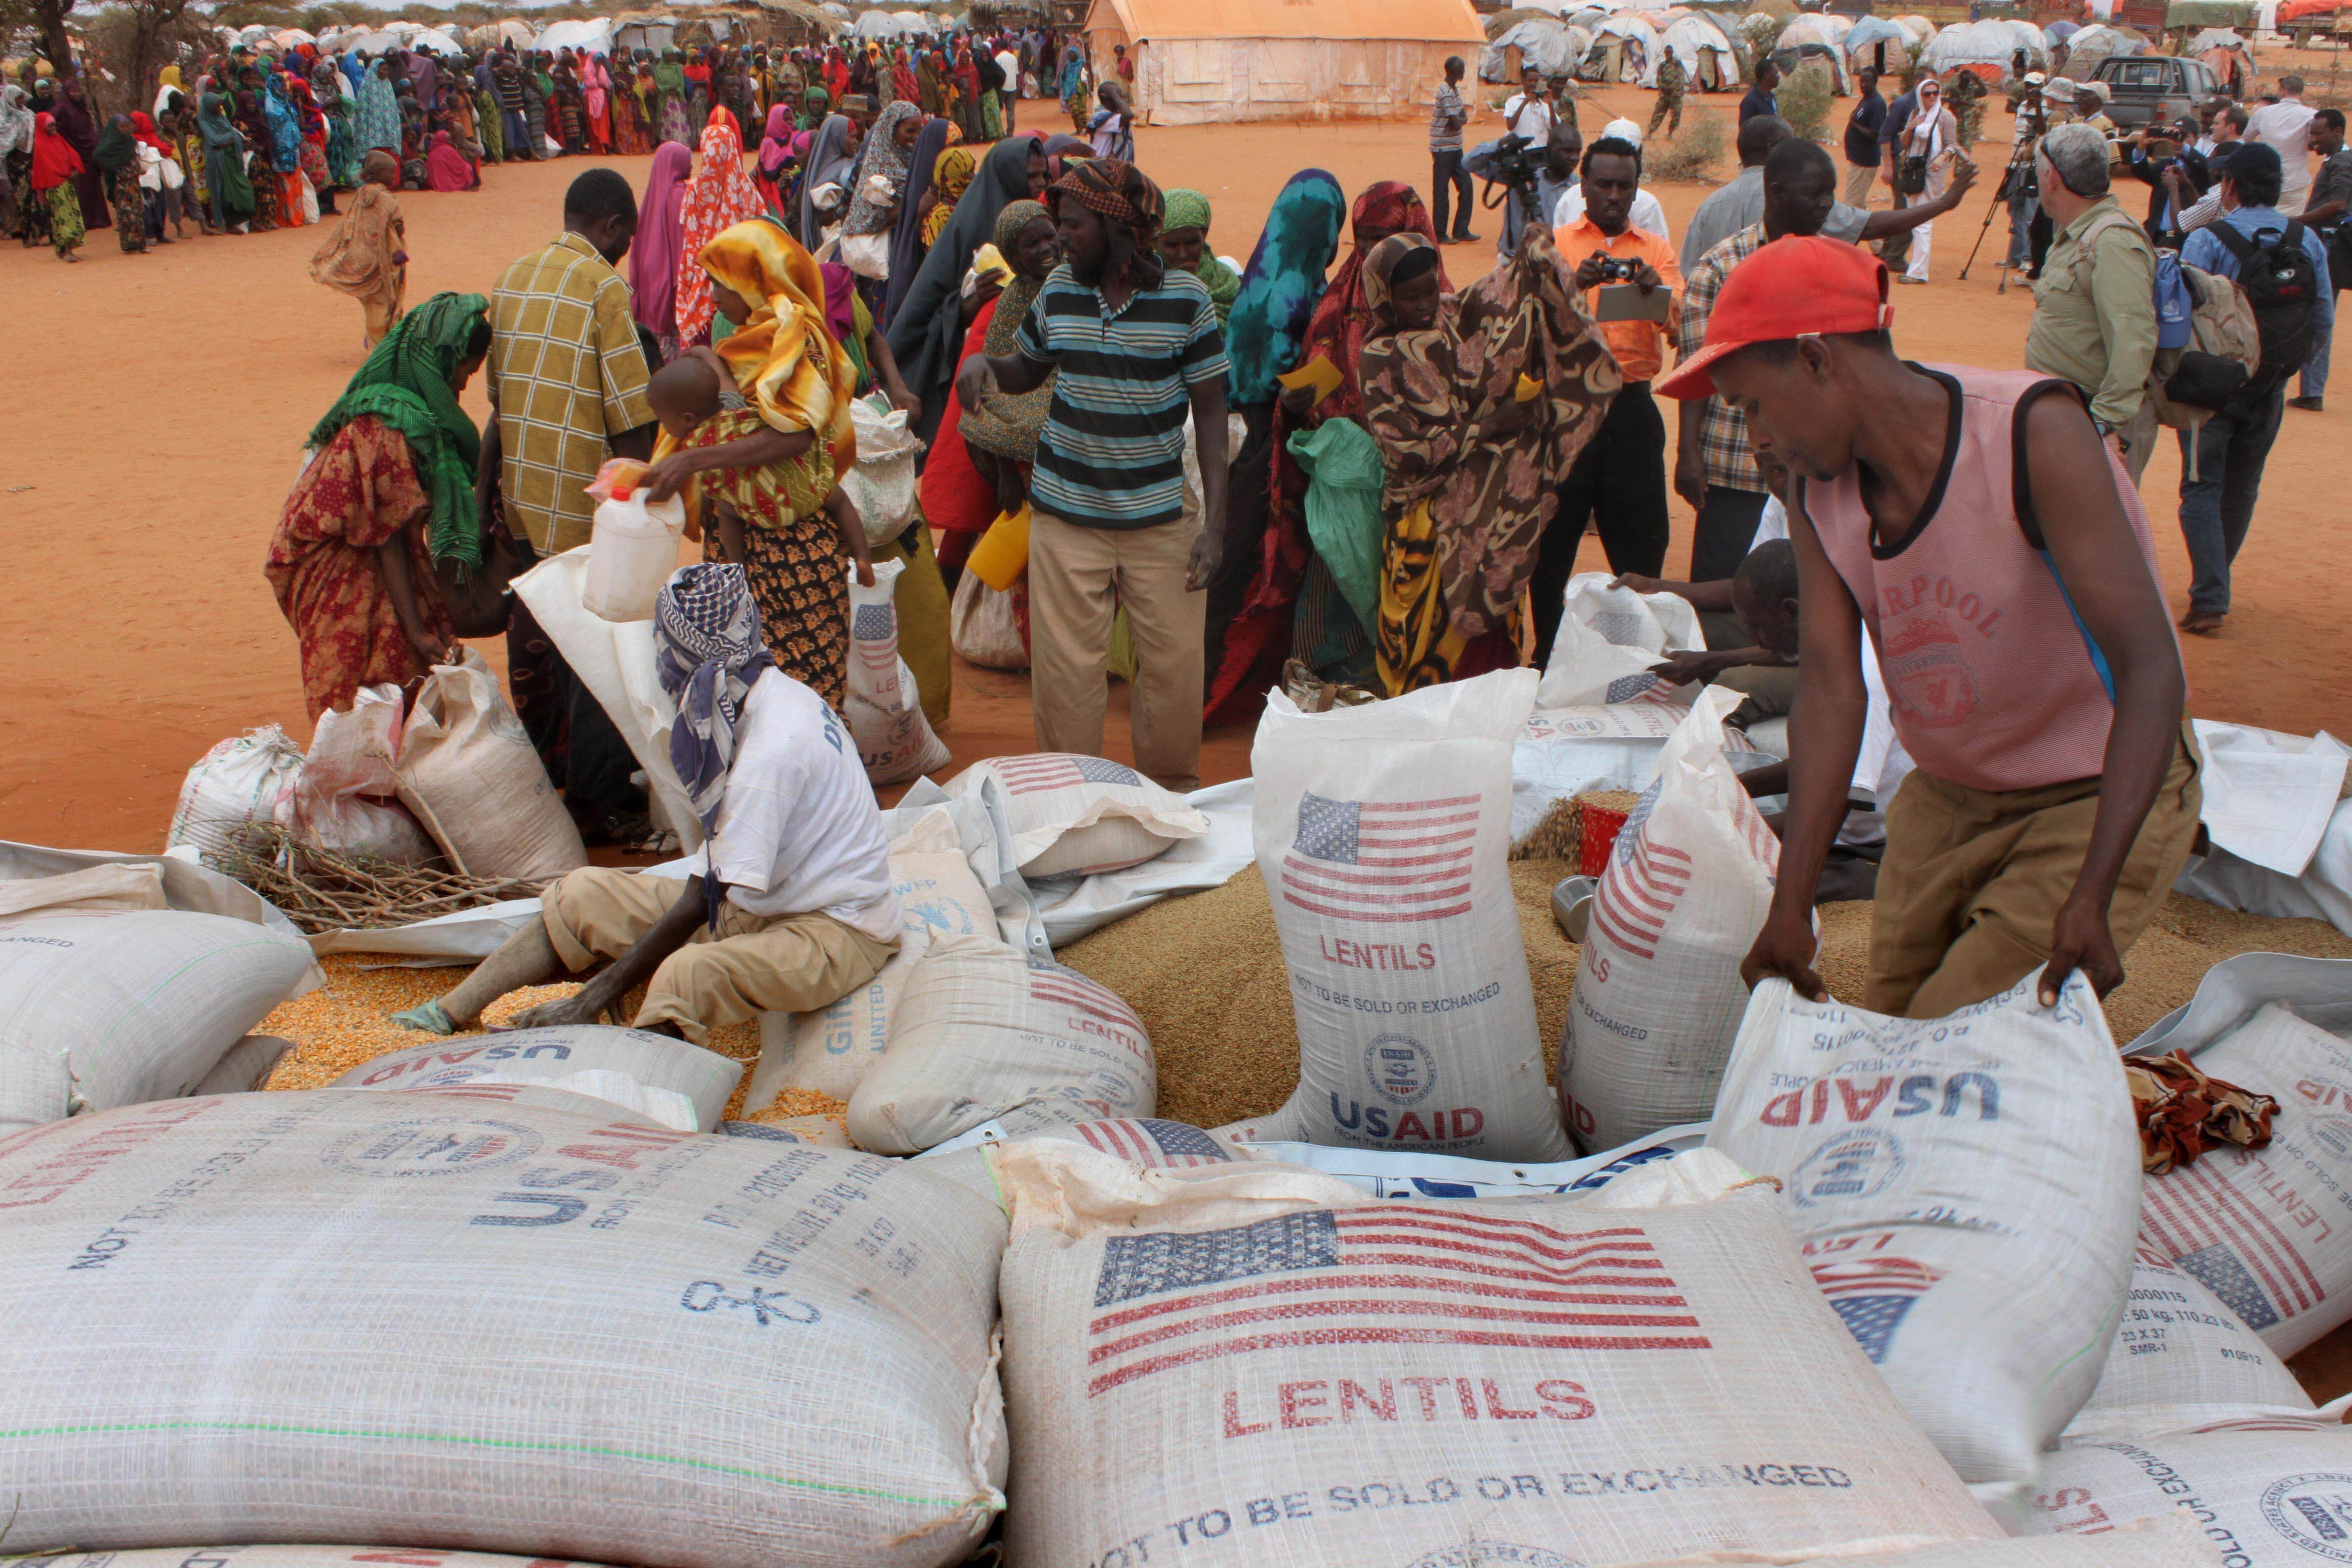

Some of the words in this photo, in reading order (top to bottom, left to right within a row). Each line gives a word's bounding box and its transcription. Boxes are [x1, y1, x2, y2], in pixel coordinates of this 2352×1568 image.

[892, 879, 936, 895] WFP
[0, 936, 75, 947] ANGED
[1320, 934, 1435, 971] LENTILS
[1295, 973, 1312, 990] NOT
[1315, 985, 1330, 1001] TO
[1333, 993, 1350, 1008] BE
[1354, 997, 1391, 1014] SOLD
[1397, 1001, 1417, 1014] OR
[1422, 981, 1500, 1014] EXCHANGED
[869, 983, 886, 1052] UNITED
[1585, 1003, 1648, 1041] EXCHANGED
[1049, 1038, 1065, 1048] TO
[1070, 1042, 1085, 1052] BE
[1089, 1048, 1121, 1064] SOLD
[1068, 1017, 1153, 1069] LENTILS
[361, 1043, 572, 1086] USAID
[1331, 1090, 1484, 1141] USAID
[1760, 1072, 1999, 1127] USAID
[1335, 1126, 1361, 1144] FROM
[1365, 1137, 1384, 1149] THE
[1387, 1141, 1445, 1151] AMERICAN
[1447, 1135, 1486, 1149] PEOPLE
[2285, 1144, 2304, 1160] OR
[2305, 1160, 2340, 1192] SOLD
[2232, 1150, 2333, 1244] LENTILS
[67, 1227, 142, 1271] NOT
[742, 1249, 791, 1279] NET
[2131, 1309, 2150, 1321] 50
[2121, 1331, 2137, 1342] 23
[2139, 1328, 2150, 1340] X
[2150, 1328, 2166, 1339] 37
[2129, 1343, 2167, 1356] SMR-1
[1224, 1377, 1595, 1439] LENTILS
[1089, 1532, 1154, 1568] OT
[1165, 1508, 1232, 1547] TO
[1245, 1491, 1314, 1527] BE
[1328, 1476, 1461, 1512] SOLD
[1476, 1474, 1546, 1501] OR
[1559, 1463, 1853, 1496] EXCHANGED
